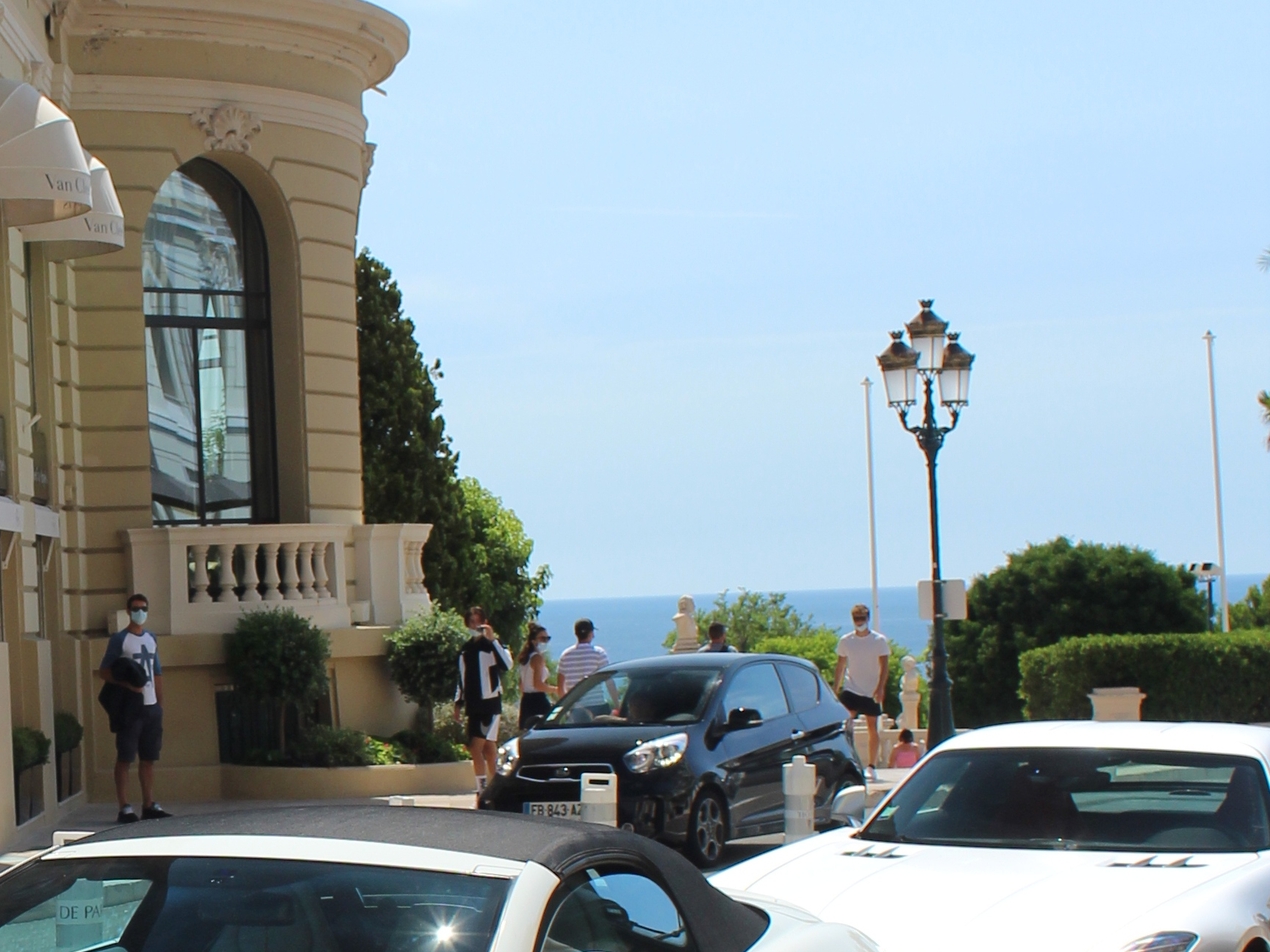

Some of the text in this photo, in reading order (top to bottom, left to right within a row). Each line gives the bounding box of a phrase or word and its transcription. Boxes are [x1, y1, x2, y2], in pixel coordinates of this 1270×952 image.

[45, 173, 72, 192] Van
[83, 217, 108, 235] Van
[59, 905, 79, 919] DE
